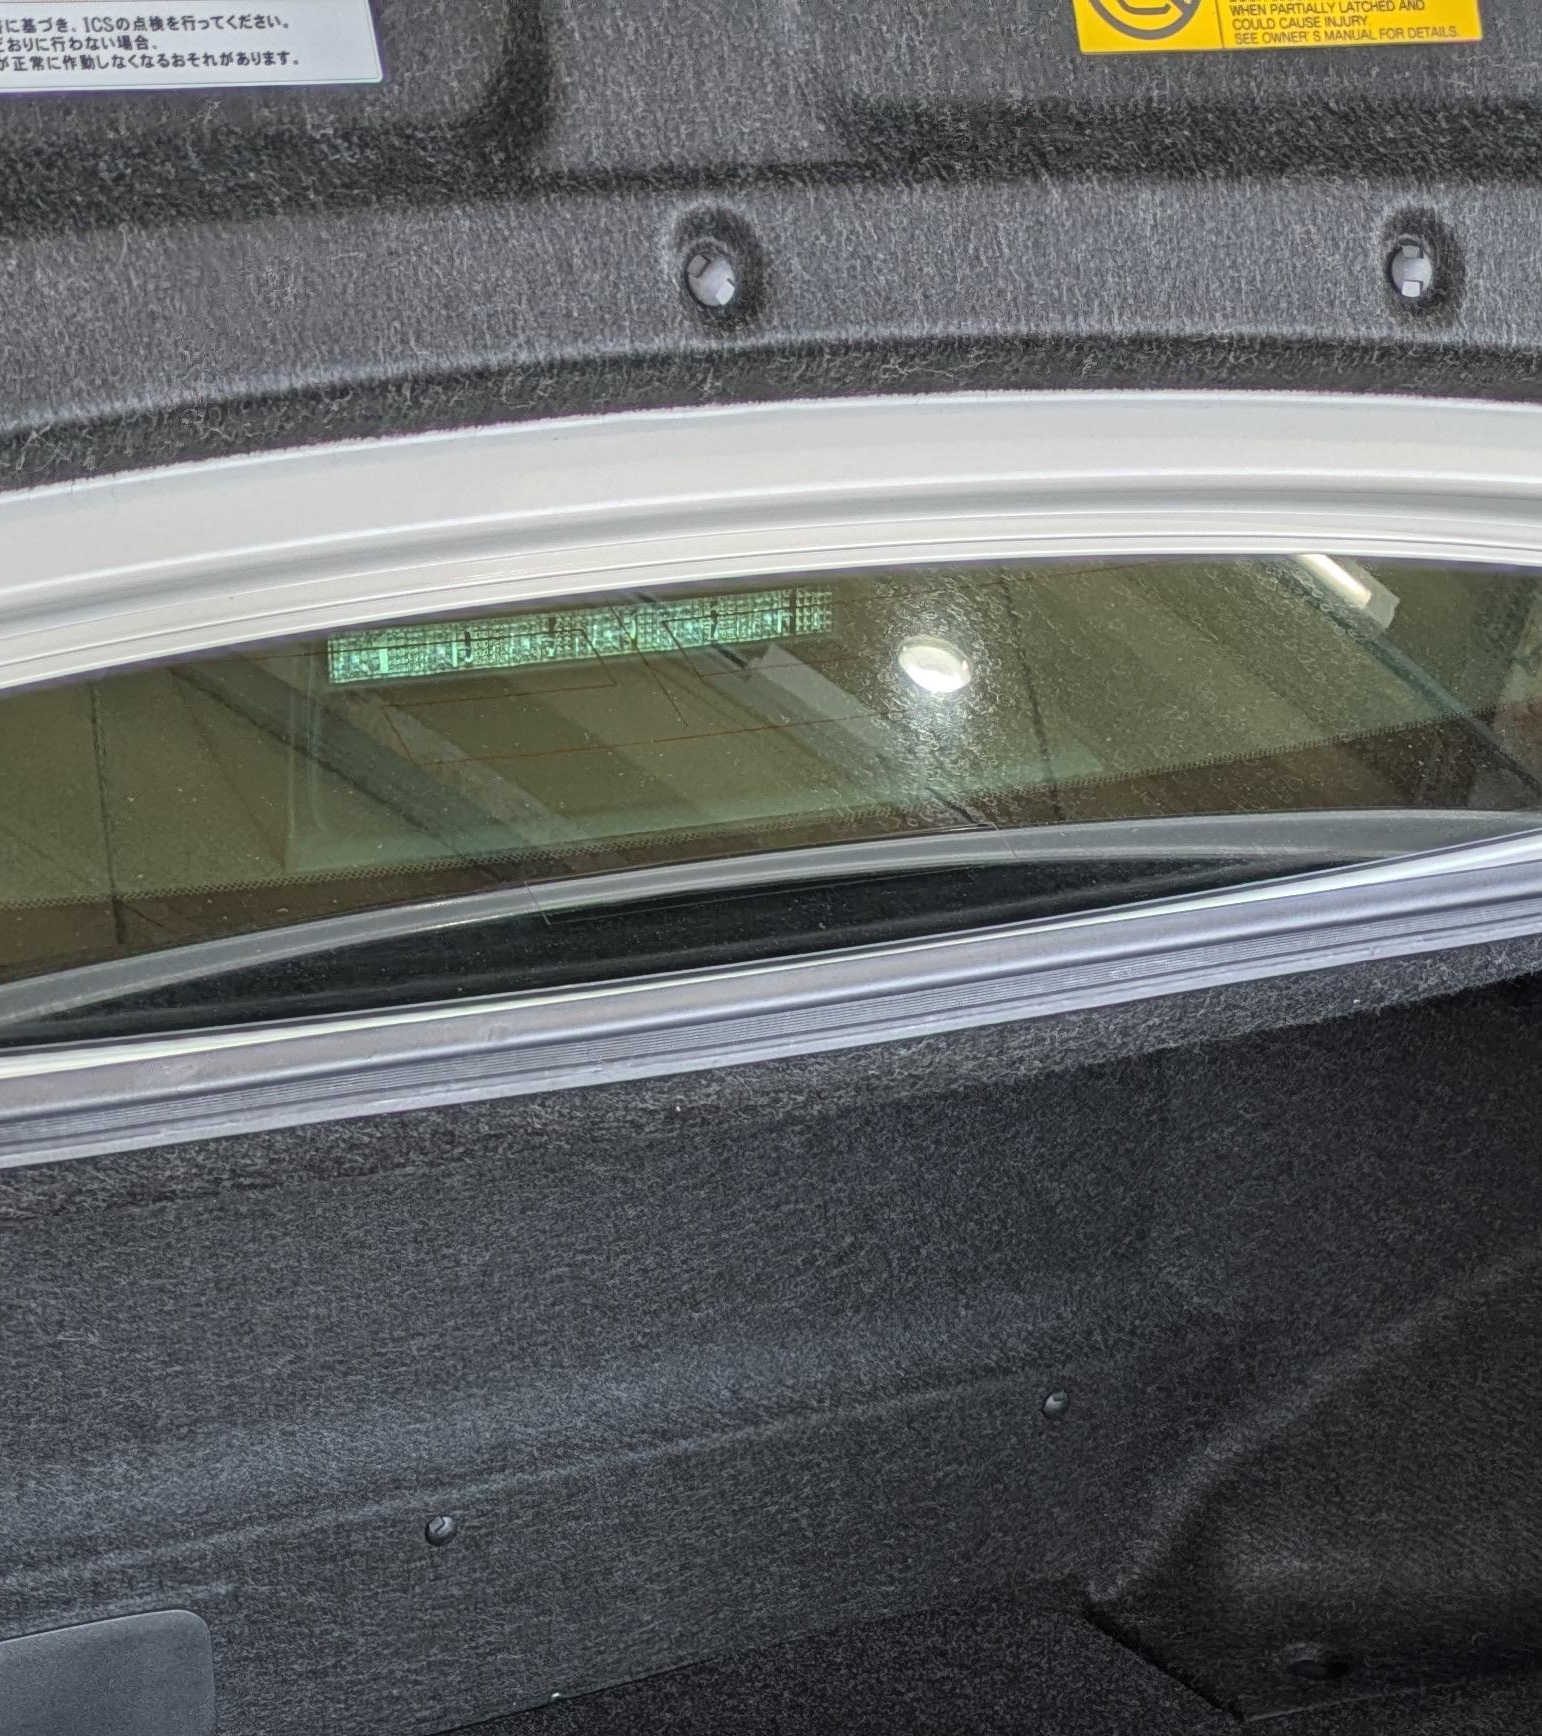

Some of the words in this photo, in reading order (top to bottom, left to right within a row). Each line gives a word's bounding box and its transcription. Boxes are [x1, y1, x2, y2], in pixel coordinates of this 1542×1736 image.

[1229, 4, 1267, 16] WHEN
[1270, 2, 1335, 15] PARTIALLY
[1339, 0, 1395, 13] LATCHED
[1398, 0, 1425, 11] AND
[1232, 18, 1276, 30] COULD
[1279, 16, 1321, 29] CAUSE
[1234, 33, 1259, 45] SEE
[1324, 28, 1376, 41] MANUAL
[1379, 27, 1404, 40] FOR
